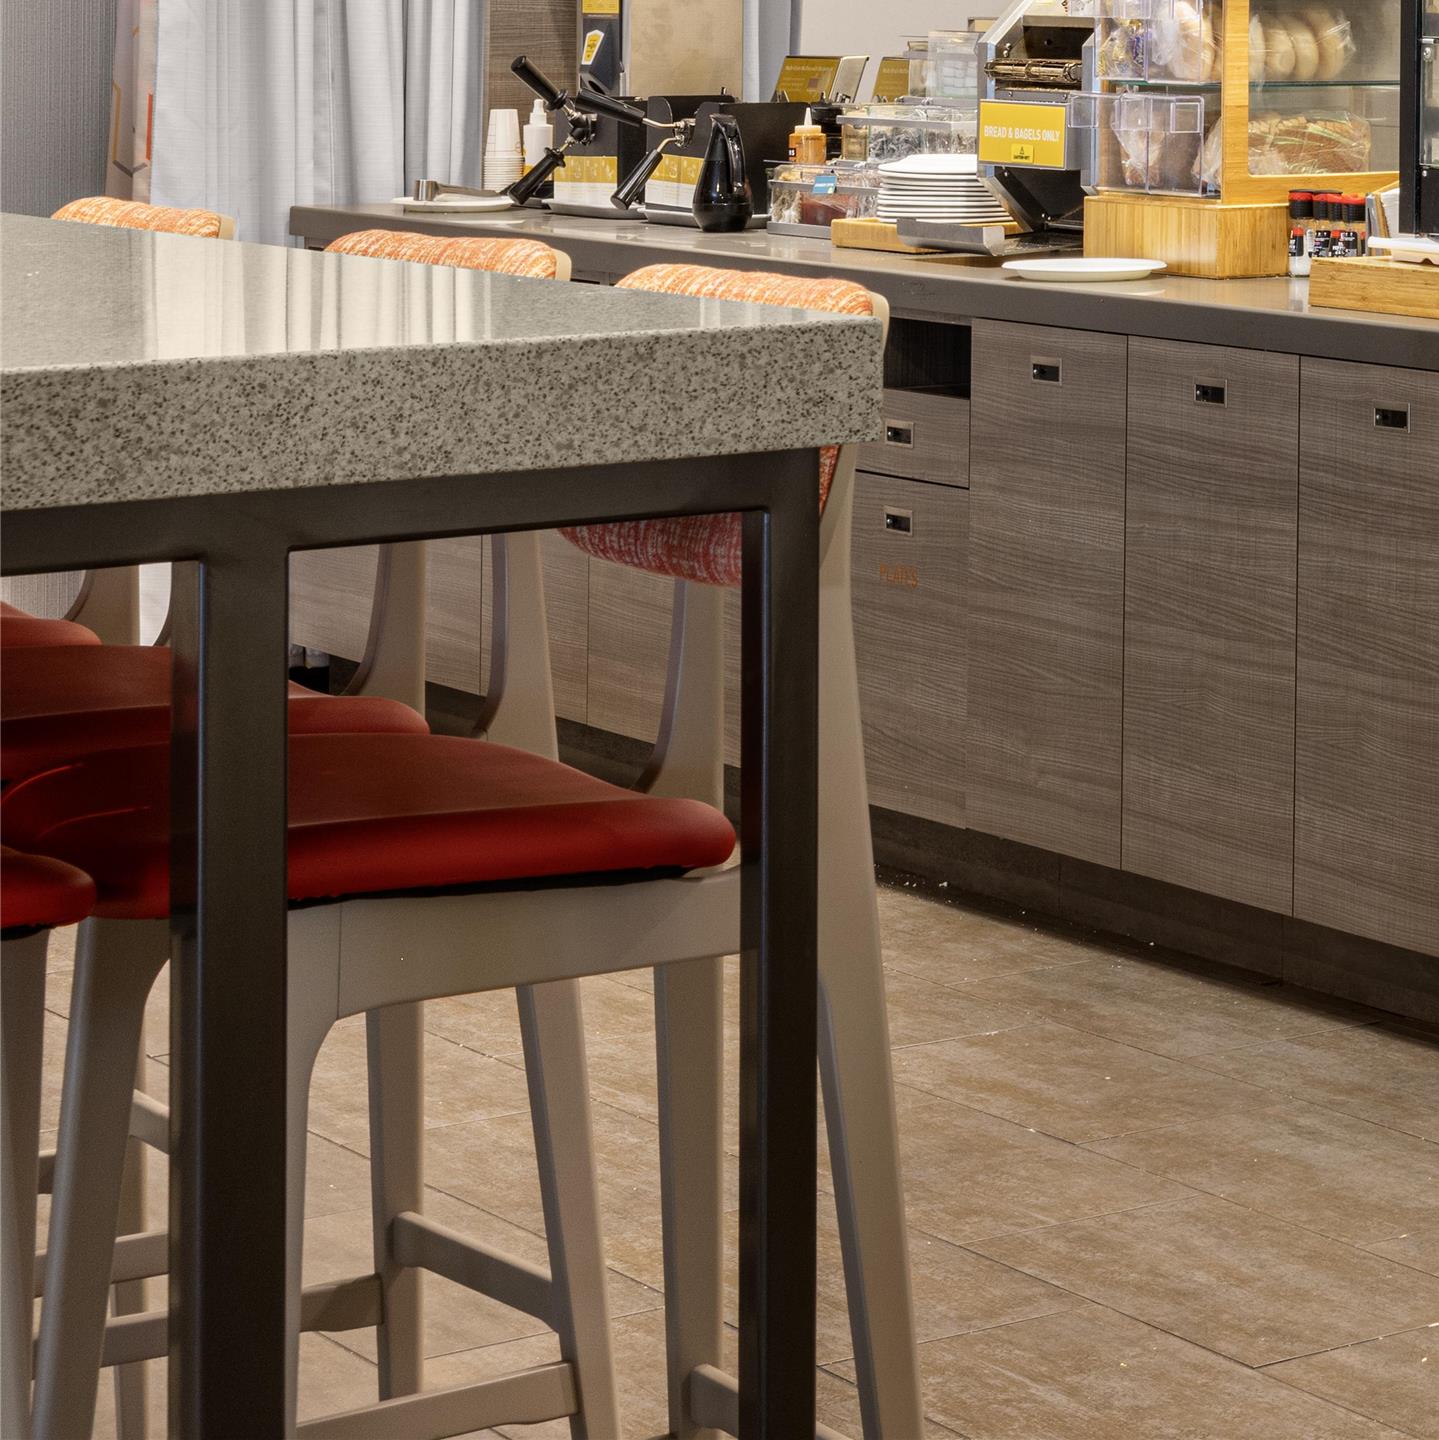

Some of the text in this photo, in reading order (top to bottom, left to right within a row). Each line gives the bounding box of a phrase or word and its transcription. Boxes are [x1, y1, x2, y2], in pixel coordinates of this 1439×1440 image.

[984, 125, 1007, 138] BREAD
[1014, 127, 1041, 141] BAGELS
[1042, 129, 1060, 142] ONLY
